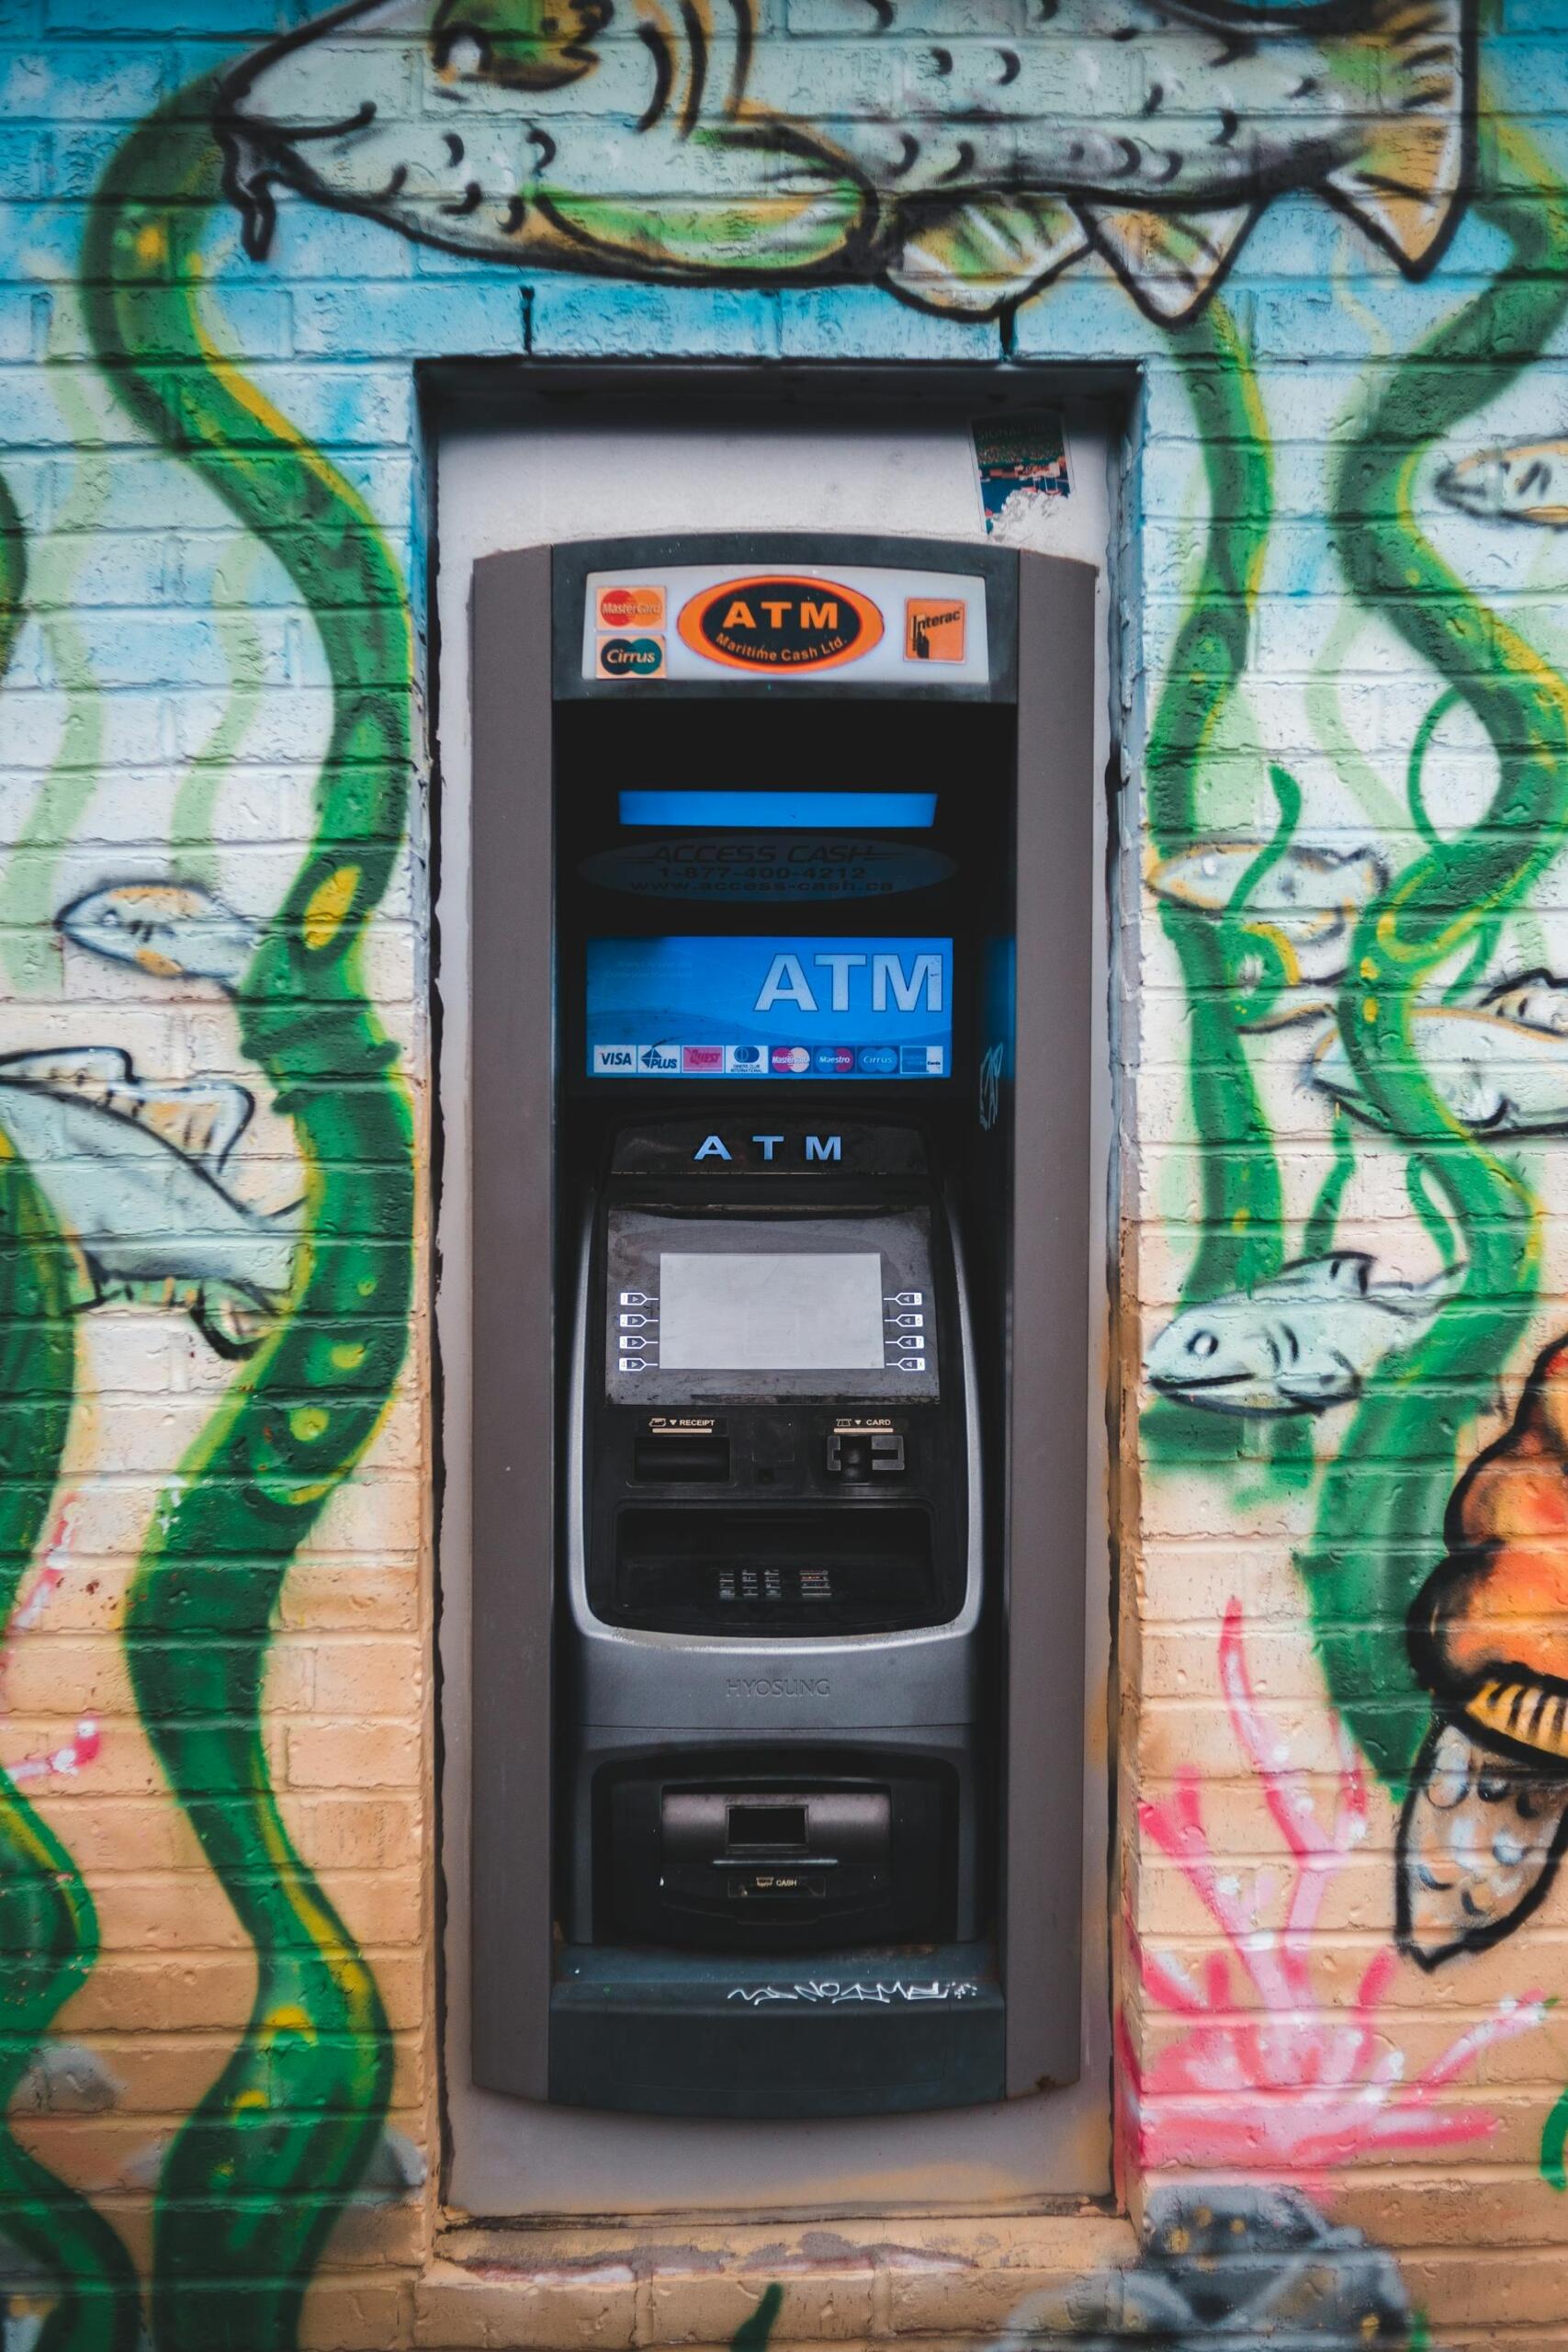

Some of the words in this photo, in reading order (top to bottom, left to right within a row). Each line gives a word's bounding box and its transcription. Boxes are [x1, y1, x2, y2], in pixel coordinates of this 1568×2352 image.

[602, 602, 661, 616] MasterCard
[722, 601, 838, 629] ATM
[912, 610, 961, 651] Interac
[716, 631, 777, 662] Maritime
[780, 646, 818, 662] Cash
[606, 648, 656, 663] Cirrus
[653, 845, 777, 864] ACCESS
[787, 845, 874, 864] CASH
[660, 866, 868, 879] 1-877-400-4212
[630, 880, 895, 892] www.access-cash.ca
[752, 953, 943, 1012] ATM
[601, 1052, 632, 1066] VISA
[650, 1058, 678, 1069] PLUS
[863, 1056, 893, 1064] Cirrus
[694, 1135, 841, 1160] ATM
[725, 1679, 830, 1697] HYOSUNG
[775, 1879, 797, 1887] CASH
